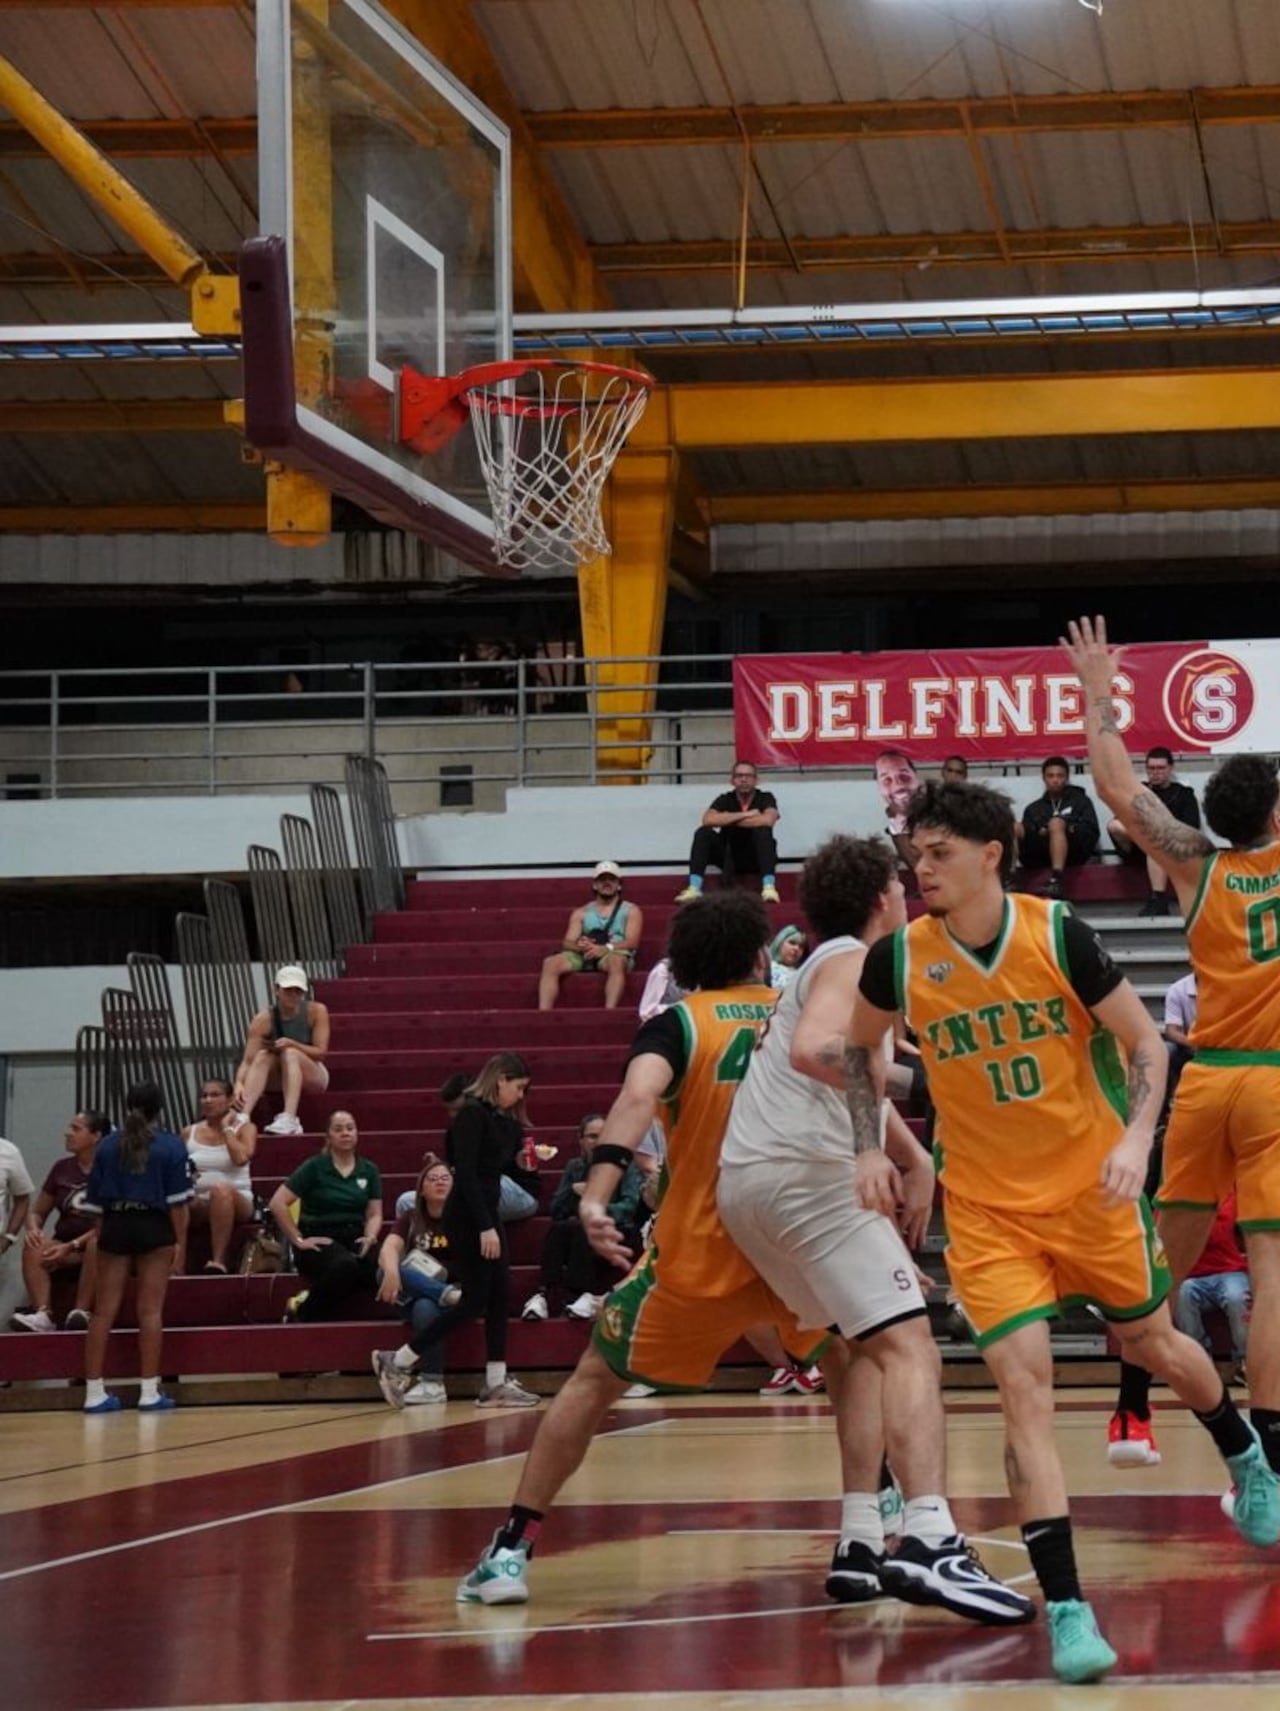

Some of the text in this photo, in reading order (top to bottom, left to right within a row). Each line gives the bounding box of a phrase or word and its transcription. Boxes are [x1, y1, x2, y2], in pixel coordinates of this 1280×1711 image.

[766, 673, 1136, 741] DELFINES
[1192, 674, 1236, 734] S
[713, 1003, 772, 1021] ROSA
[926, 996, 1070, 1062] INTER
[714, 1027, 756, 1083] 4
[985, 1054, 1043, 1105] 10
[893, 1269, 912, 1291] S
